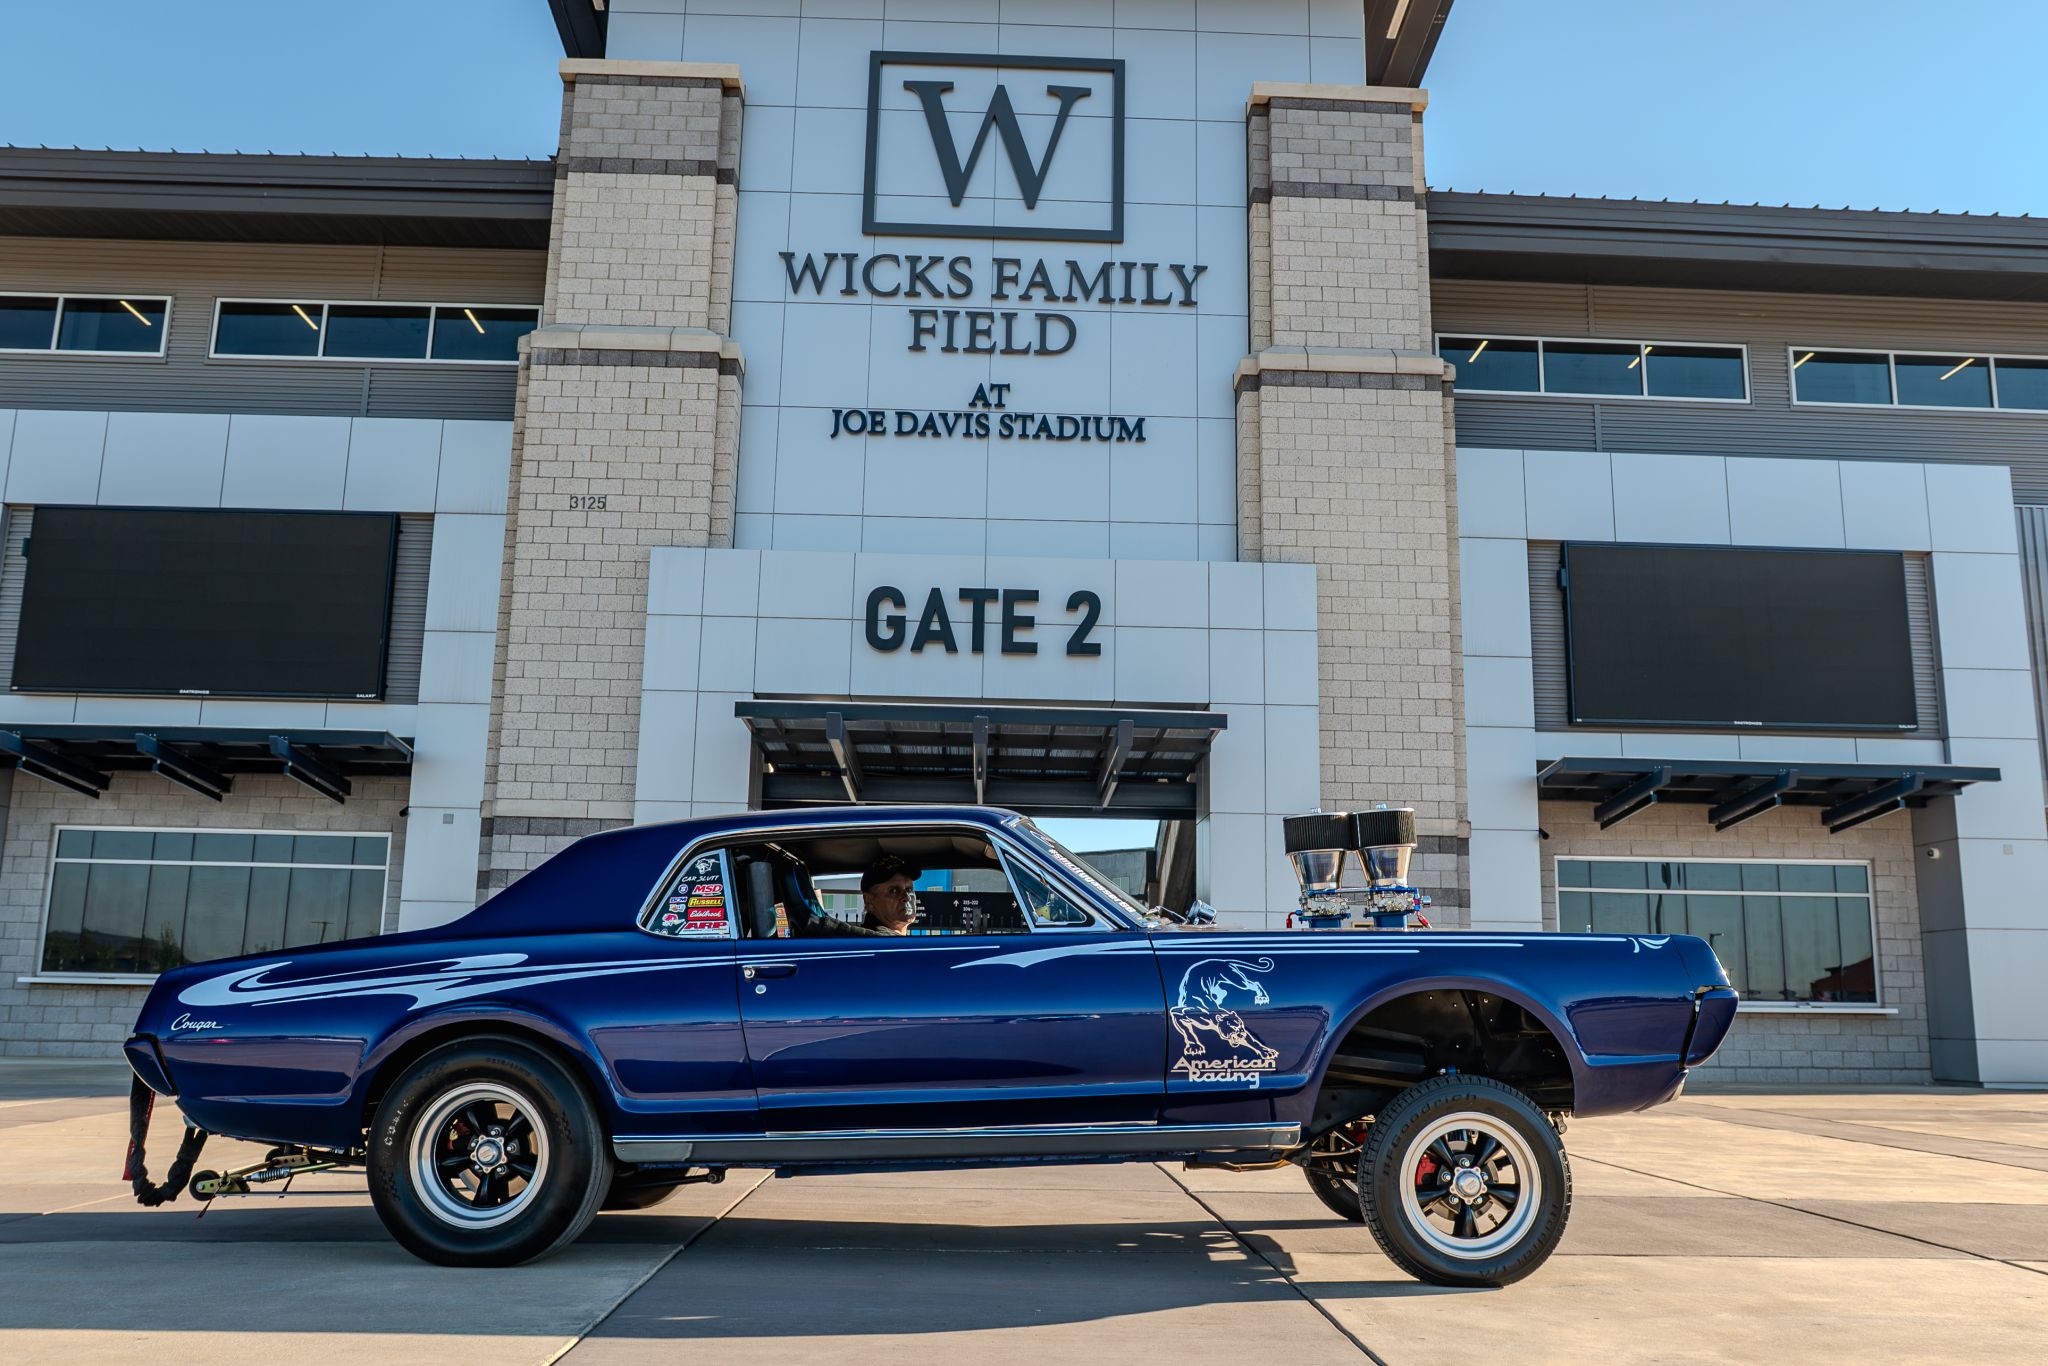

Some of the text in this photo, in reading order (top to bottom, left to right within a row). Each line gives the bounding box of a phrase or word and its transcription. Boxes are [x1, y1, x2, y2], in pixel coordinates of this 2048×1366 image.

[903, 80, 1092, 210] W
[778, 251, 1208, 306] WICKS FAMILY
[908, 309, 1077, 355] FIELD
[968, 382, 1011, 408] AT
[831, 409, 1146, 441] JOE DAVIS STADIUM
[570, 496, 606, 510] 3125
[865, 585, 1102, 656] GATE 2
[693, 884, 723, 893] MSD
[690, 898, 722, 906] RUSSELL
[171, 1012, 224, 1032] Cougar
[1172, 1055, 1276, 1070] American
[1188, 1069, 1260, 1089] Racing
